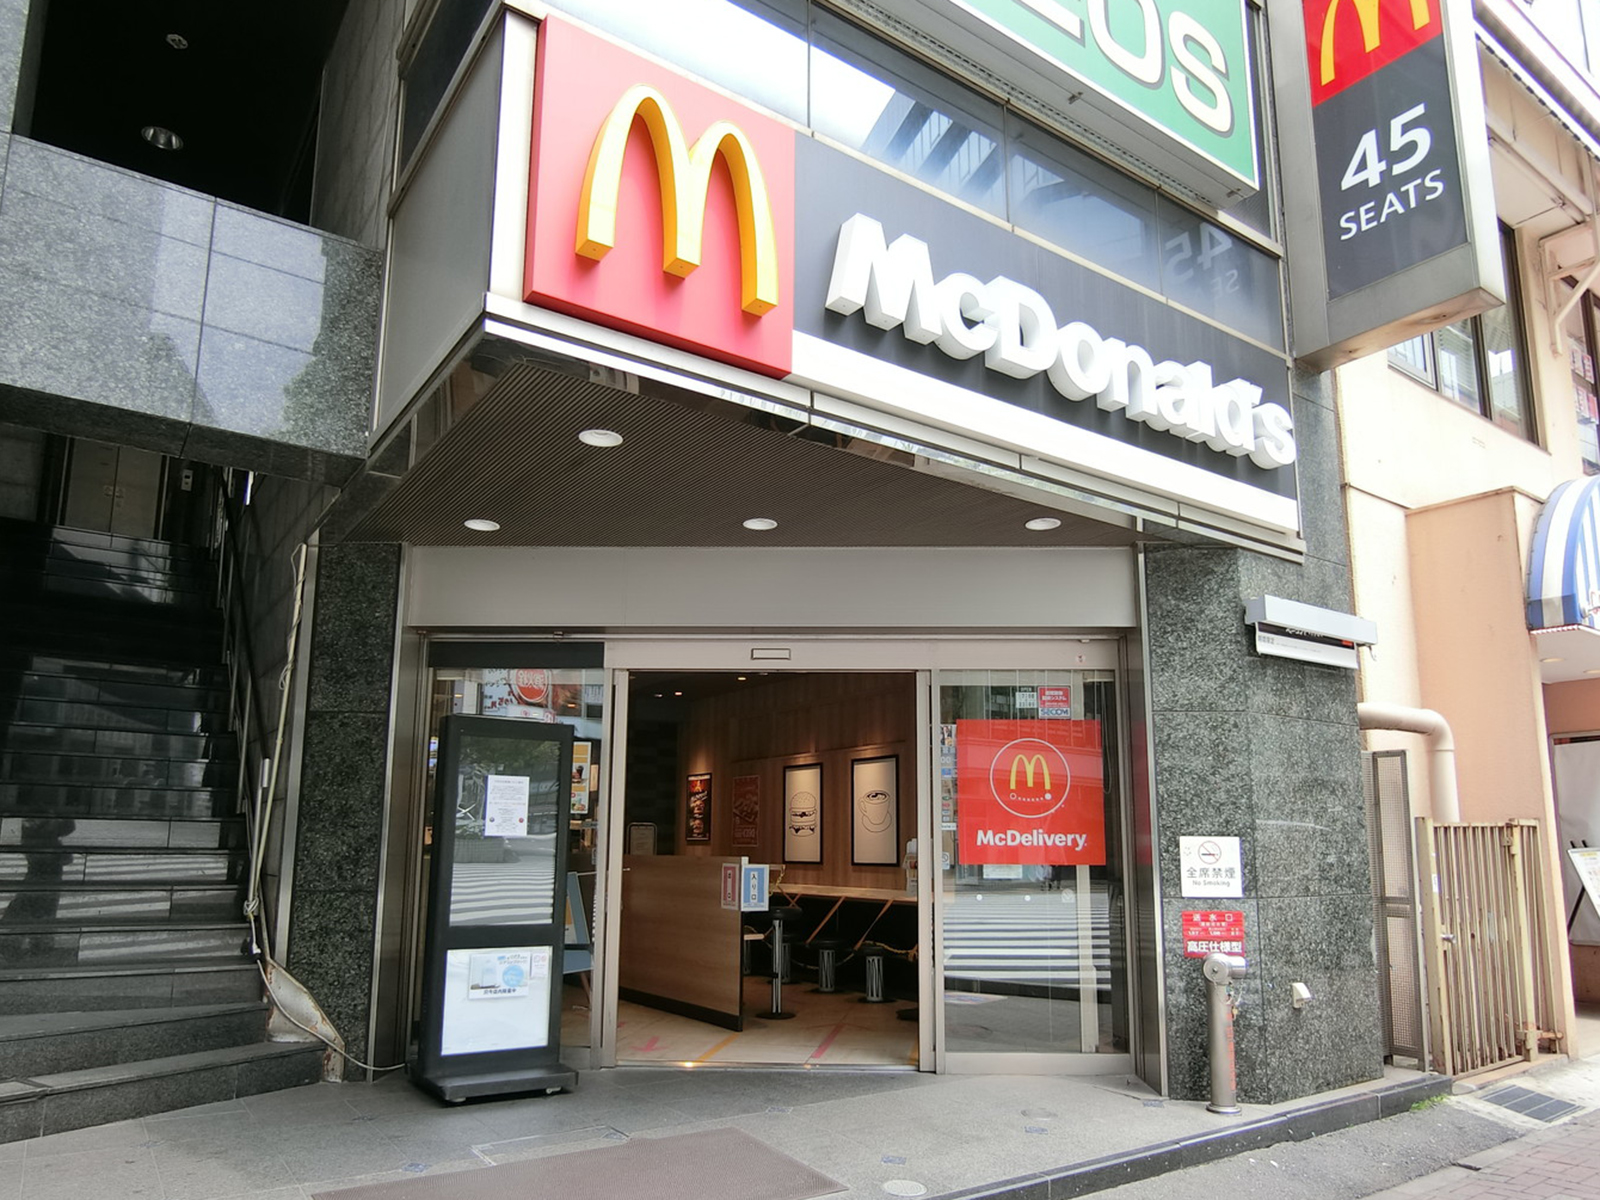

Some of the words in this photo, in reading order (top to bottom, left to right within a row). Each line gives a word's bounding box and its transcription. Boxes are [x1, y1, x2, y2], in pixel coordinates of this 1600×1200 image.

[1341, 102, 1432, 191] 45
[1339, 169, 1444, 240] SEATS
[825, 213, 1297, 470] McDonald's
[1039, 708, 1069, 717] SECOM
[976, 828, 1087, 852] McDelivery
[1186, 866, 1237, 880] 全席禁煙
[1203, 879, 1231, 888] Smoking
[750, 872, 758, 901] 入り口
[1186, 940, 1243, 953] 高圧仕様型
